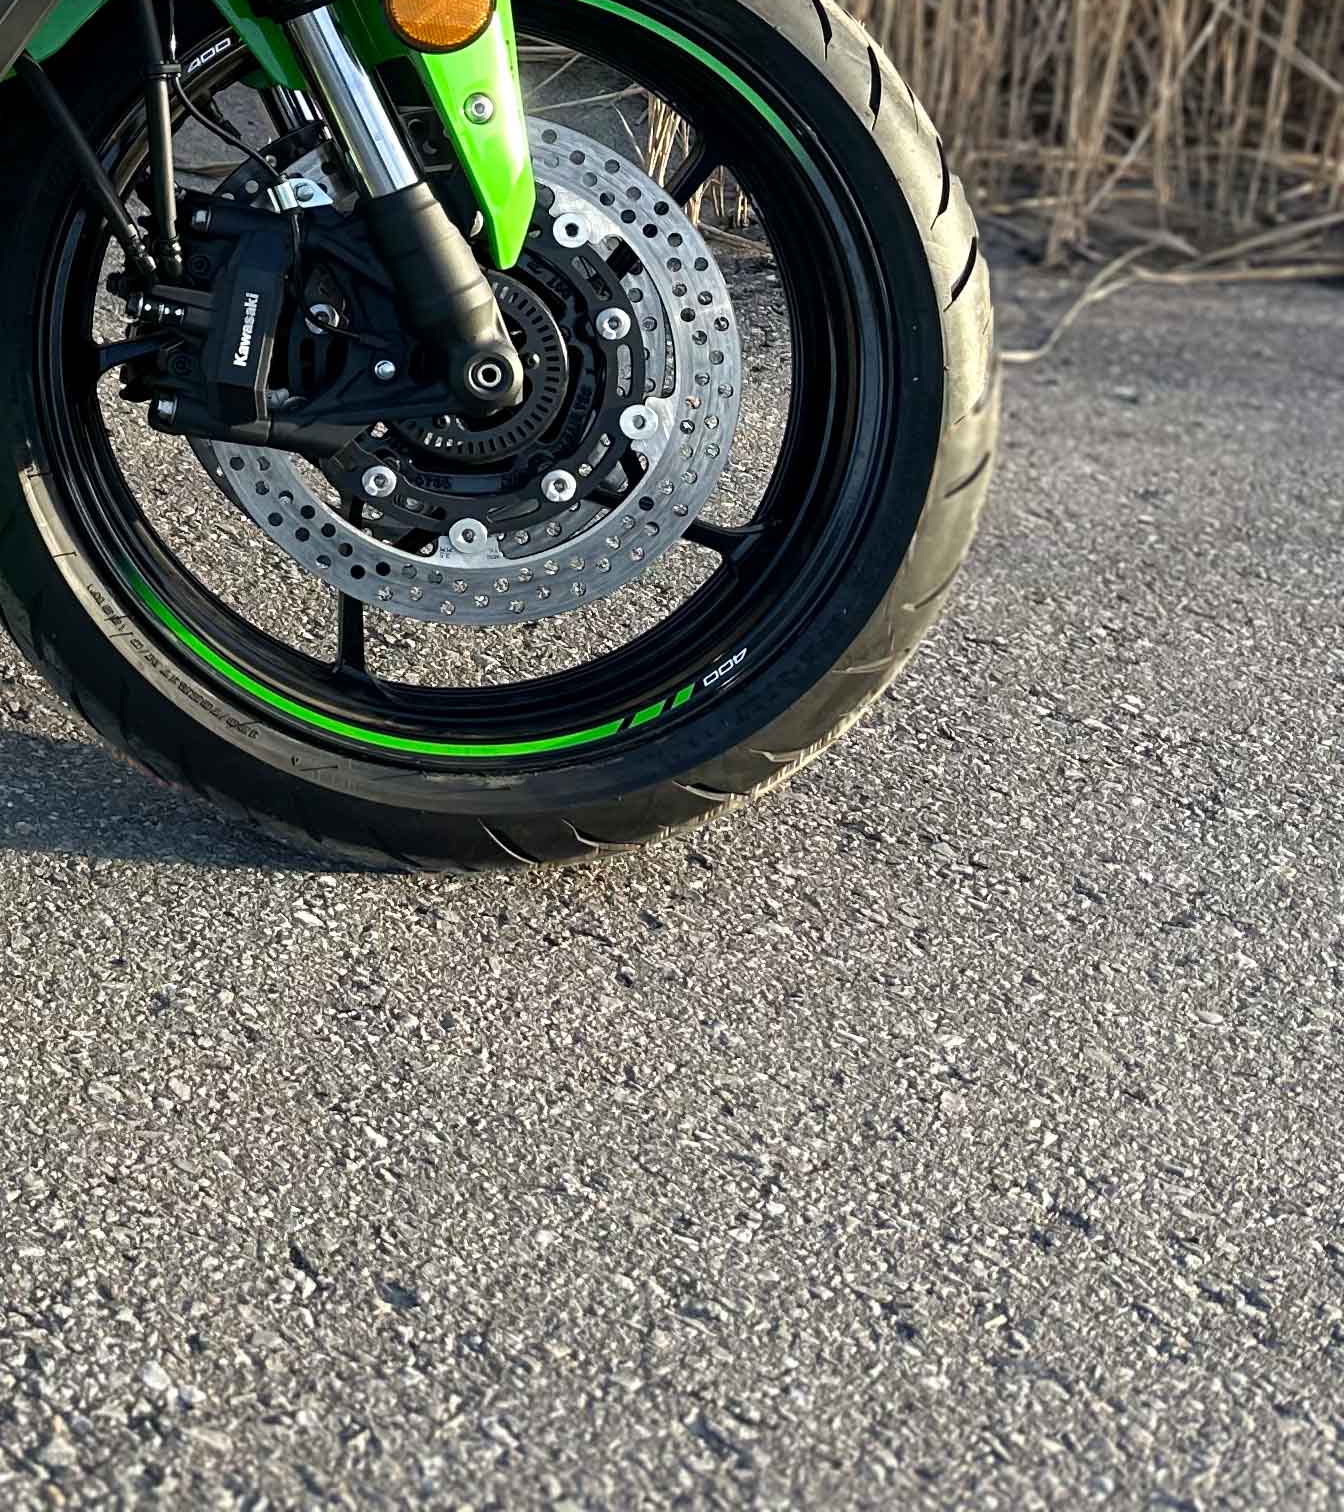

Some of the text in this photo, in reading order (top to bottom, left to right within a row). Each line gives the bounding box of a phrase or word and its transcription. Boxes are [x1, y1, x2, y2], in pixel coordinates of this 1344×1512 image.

[187, 38, 231, 72] 400
[233, 292, 259, 366] Kawasaki
[703, 648, 747, 687] 400
